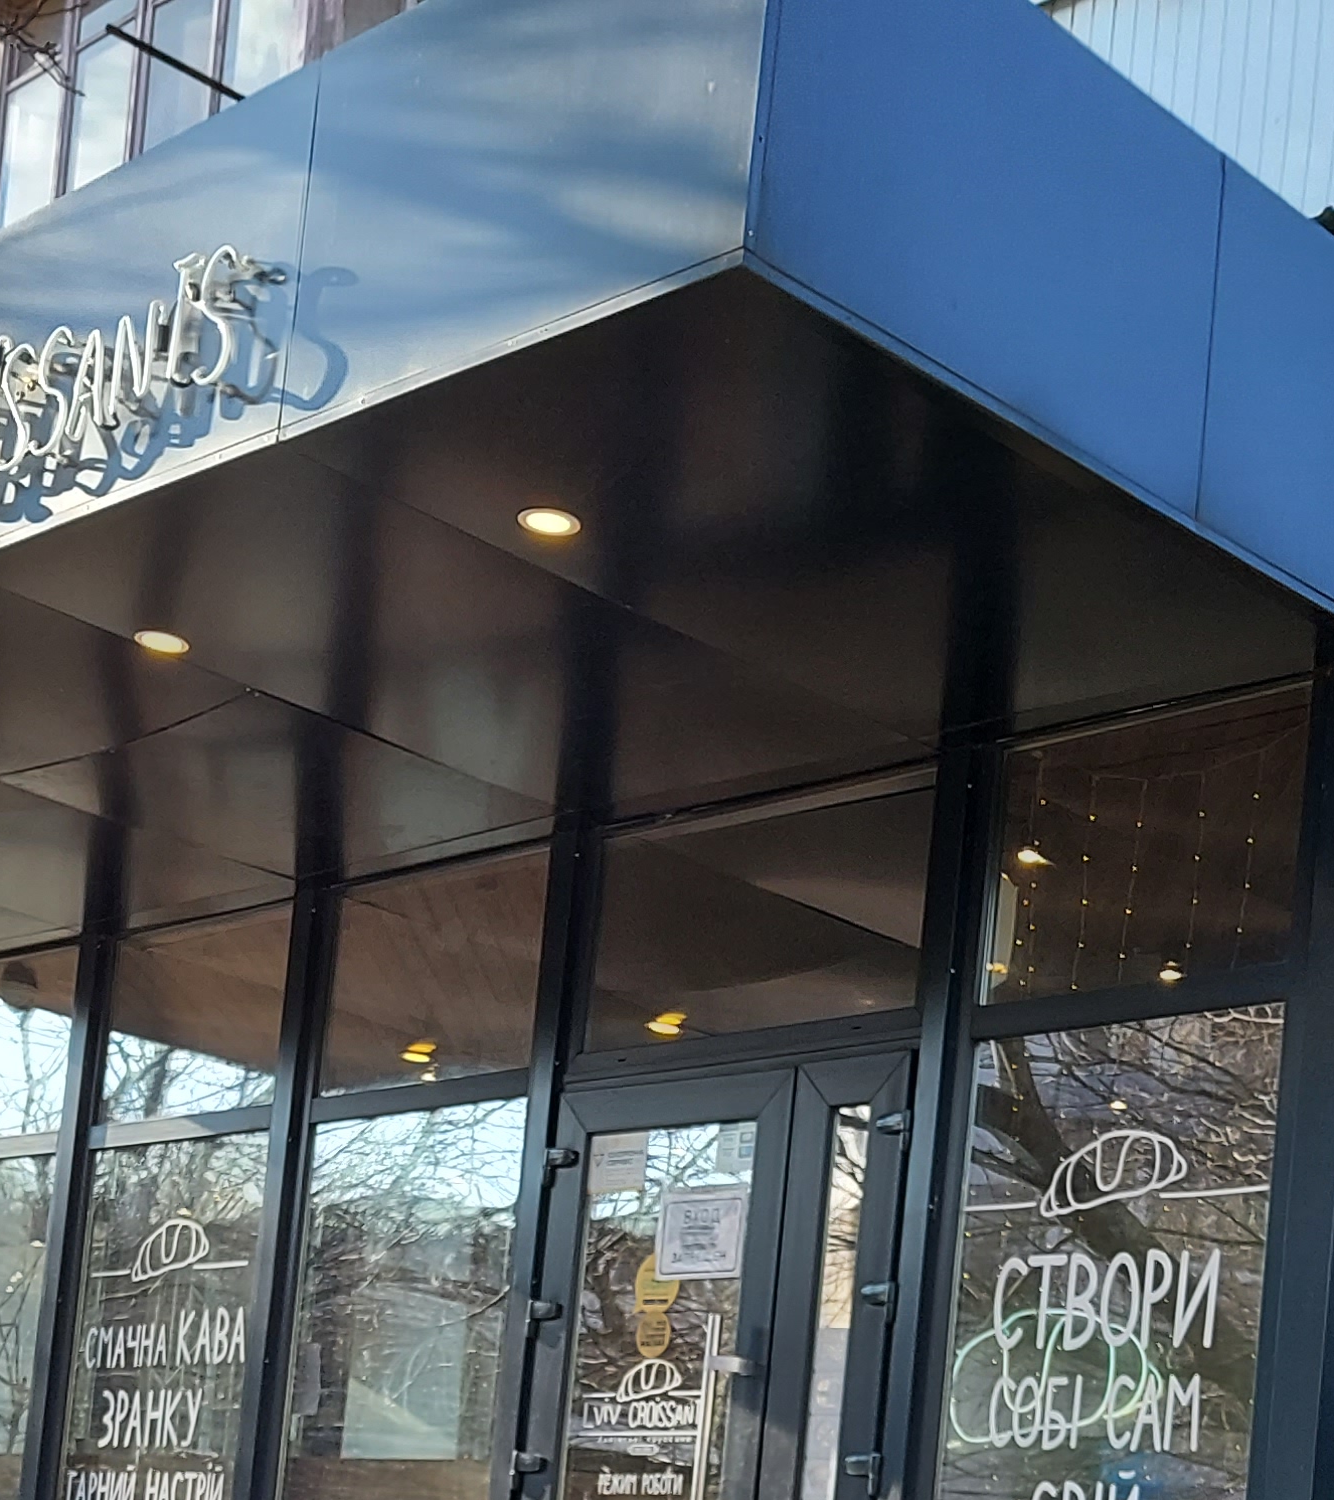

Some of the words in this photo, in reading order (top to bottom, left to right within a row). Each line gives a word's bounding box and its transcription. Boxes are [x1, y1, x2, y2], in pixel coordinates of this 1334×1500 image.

[683, 1208, 721, 1226] ВХОД
[992, 1247, 1221, 1350] СТВОРИ
[84, 1323, 168, 1370] СМАЧНА
[175, 1305, 247, 1366] КАВА
[97, 1388, 204, 1449] ЗРАНКУ
[628, 1397, 700, 1429] CROISSANT
[988, 1373, 1083, 1453] СОБІ
[1104, 1373, 1201, 1454] САМ
[641, 1472, 685, 1496] РОБОТИ
